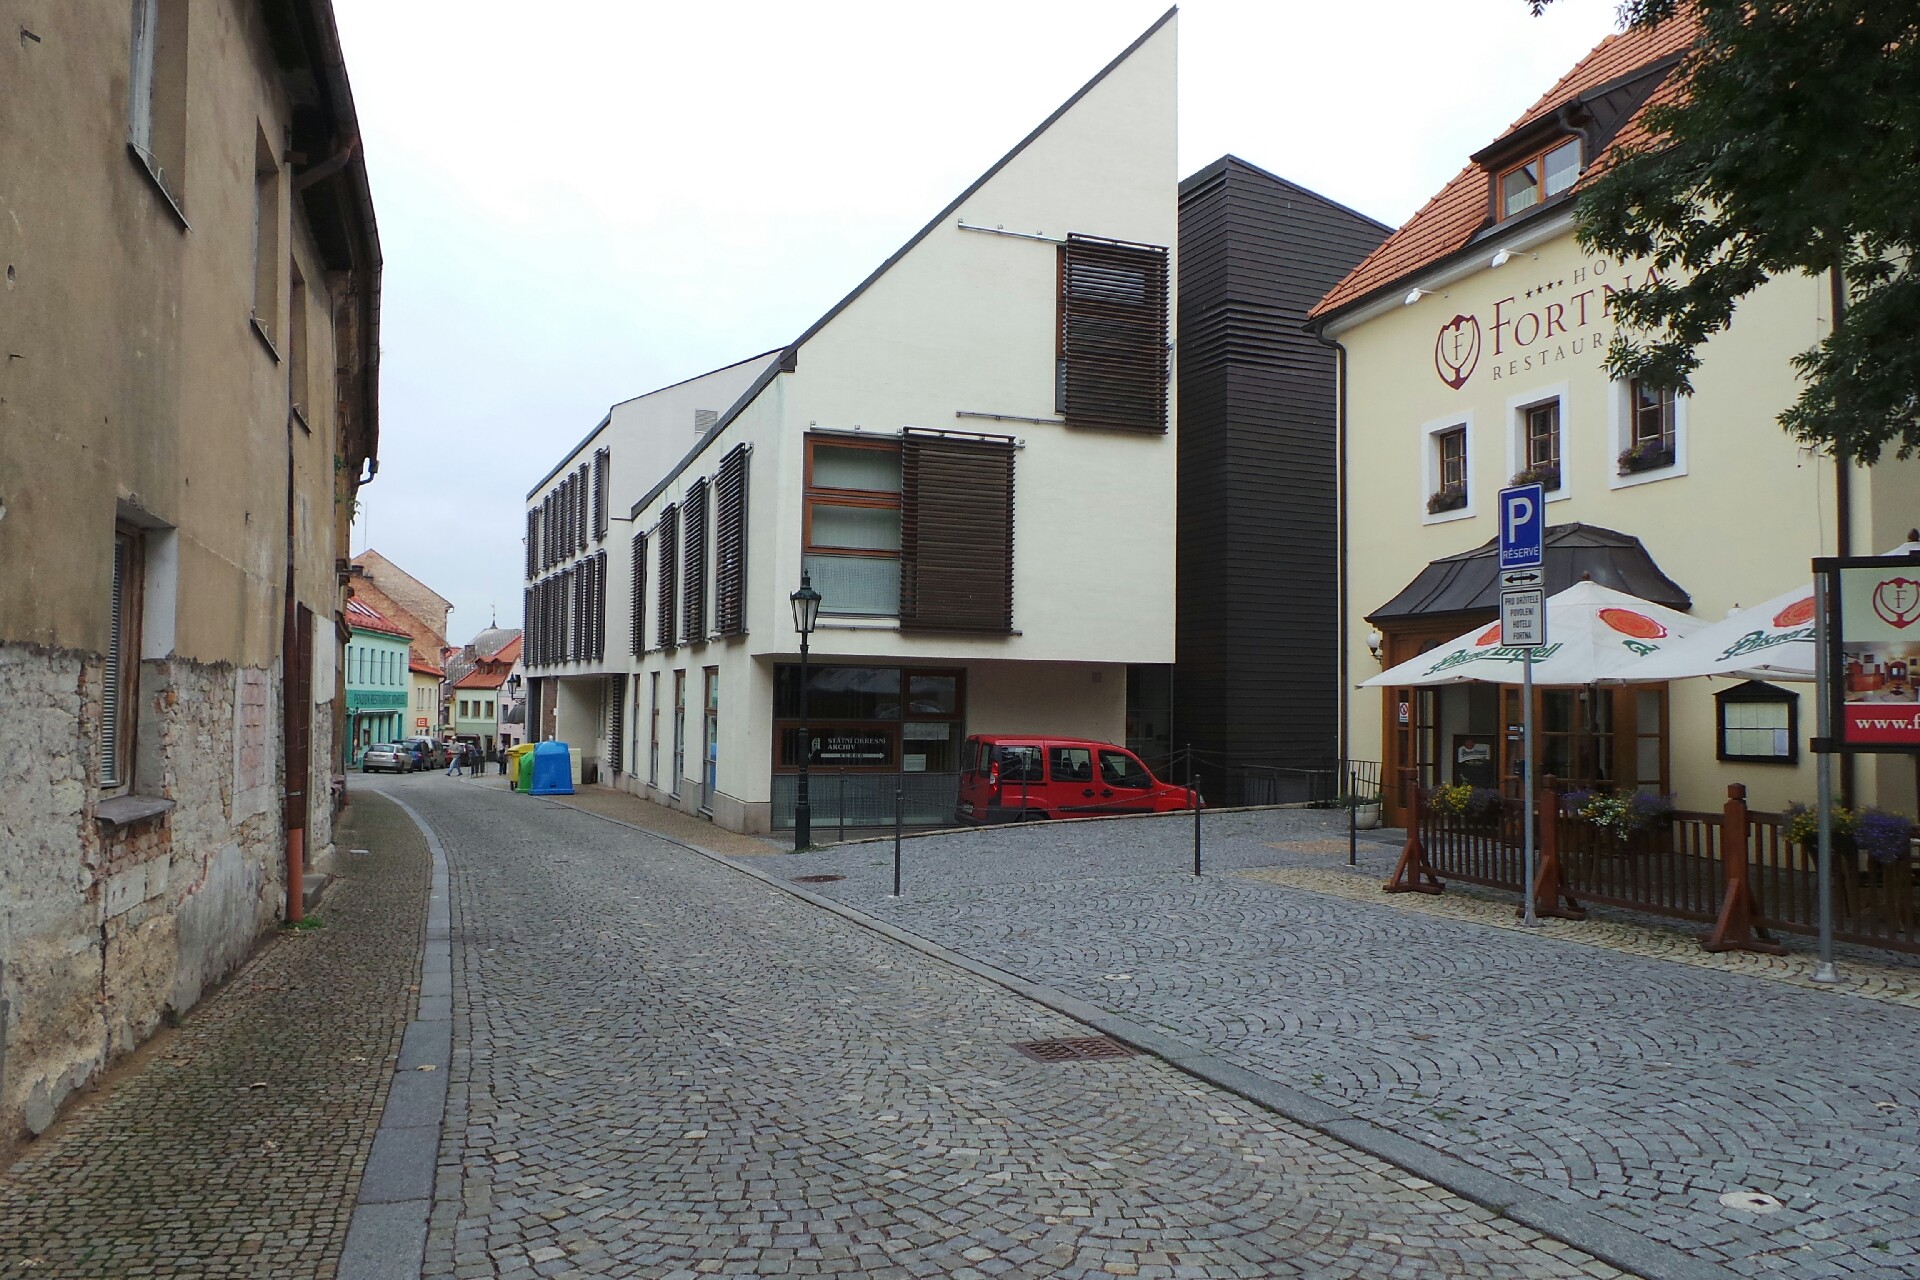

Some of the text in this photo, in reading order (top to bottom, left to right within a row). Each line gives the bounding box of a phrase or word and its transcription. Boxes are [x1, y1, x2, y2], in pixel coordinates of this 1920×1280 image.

[1508, 497, 1533, 543] P
[1502, 546, 1539, 560] RÉSERVÉ
[1504, 594, 1539, 605] PRO DRŽITELE
[1512, 619, 1532, 628] HOTELU
[1512, 631, 1532, 640] FORTNA
[827, 736, 886, 745] STÁTNÍ OKRESNÍ
